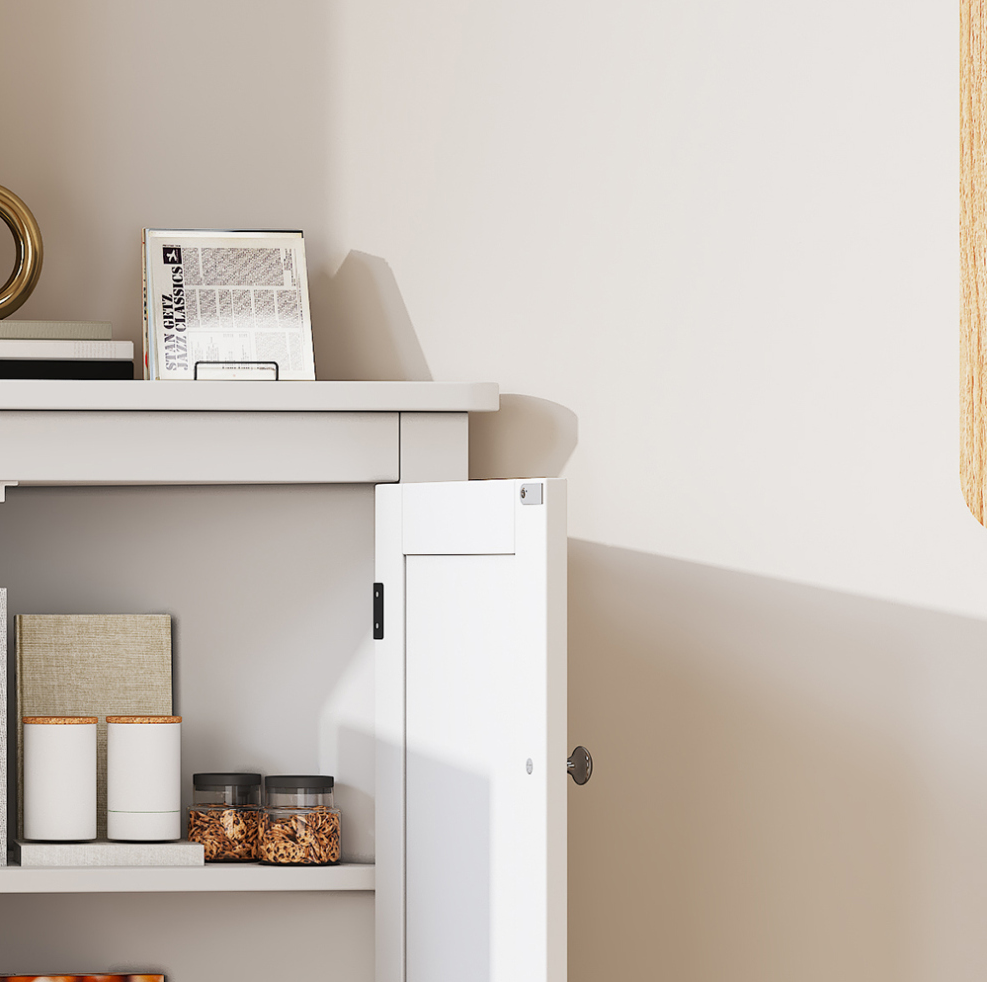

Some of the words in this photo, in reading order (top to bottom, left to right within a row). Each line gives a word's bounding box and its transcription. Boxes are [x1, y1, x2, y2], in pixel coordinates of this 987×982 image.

[161, 294, 174, 329] GETZ
[171, 266, 187, 332] CLASSICS
[164, 333, 177, 371] STAN
[175, 335, 188, 370] JAZZ
